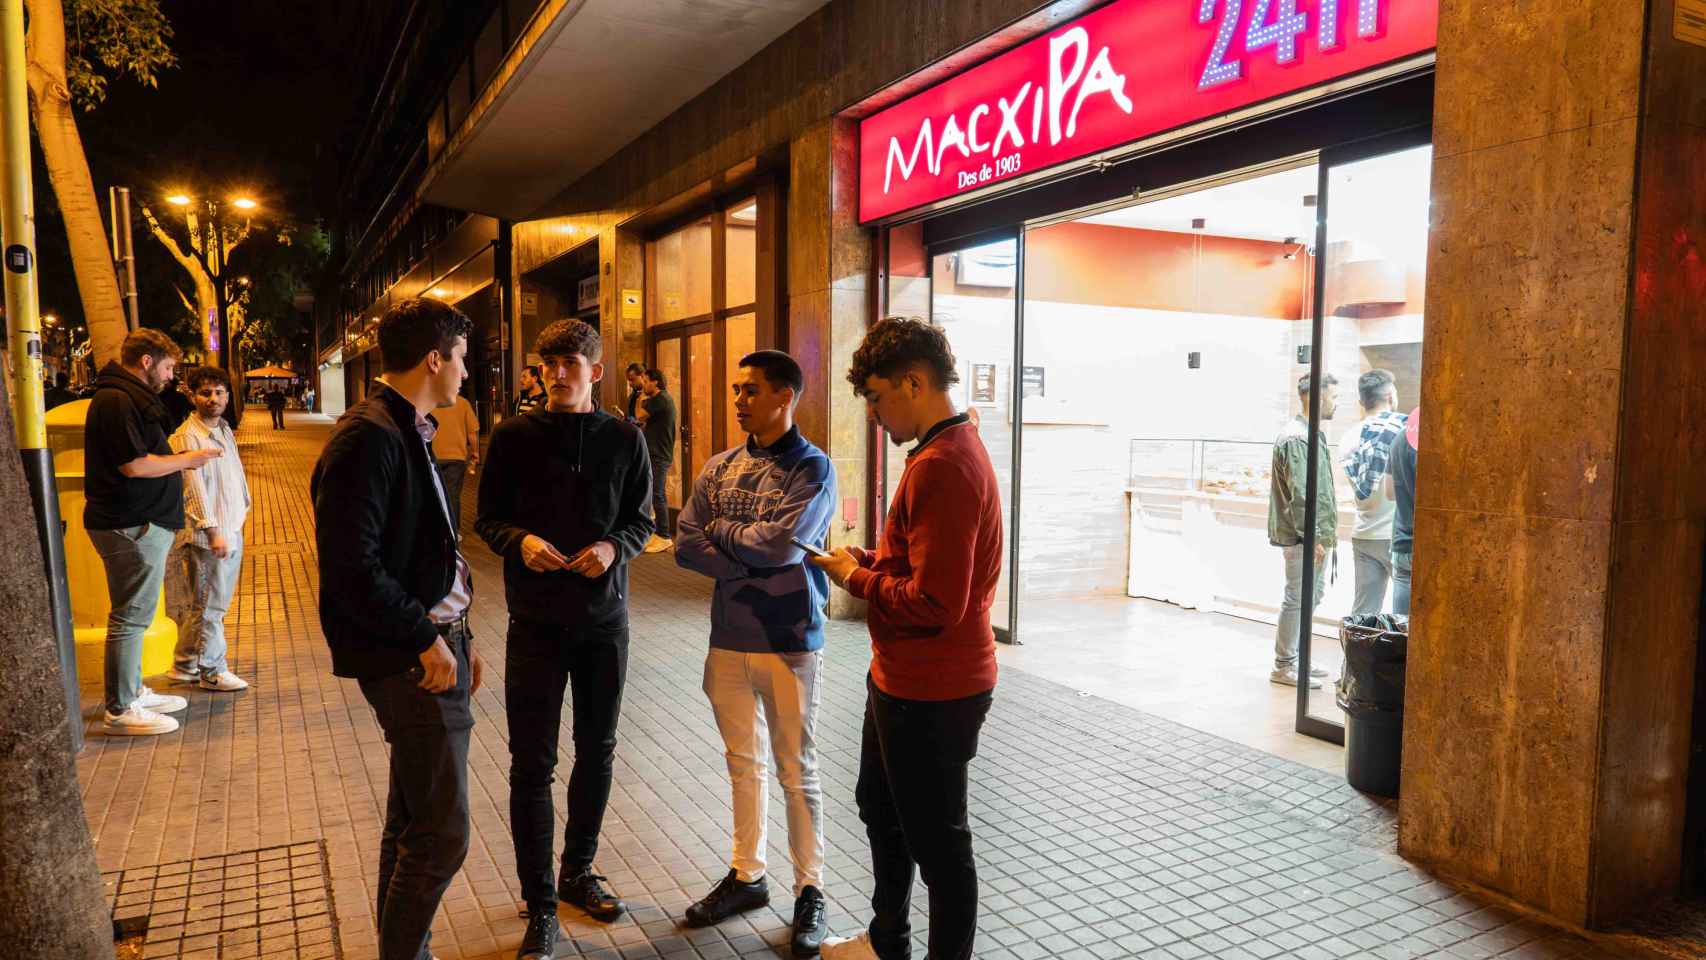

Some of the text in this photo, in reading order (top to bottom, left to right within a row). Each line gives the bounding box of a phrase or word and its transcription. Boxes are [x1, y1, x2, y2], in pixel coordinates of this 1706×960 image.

[958, 152, 1021, 189] Des de 1903
